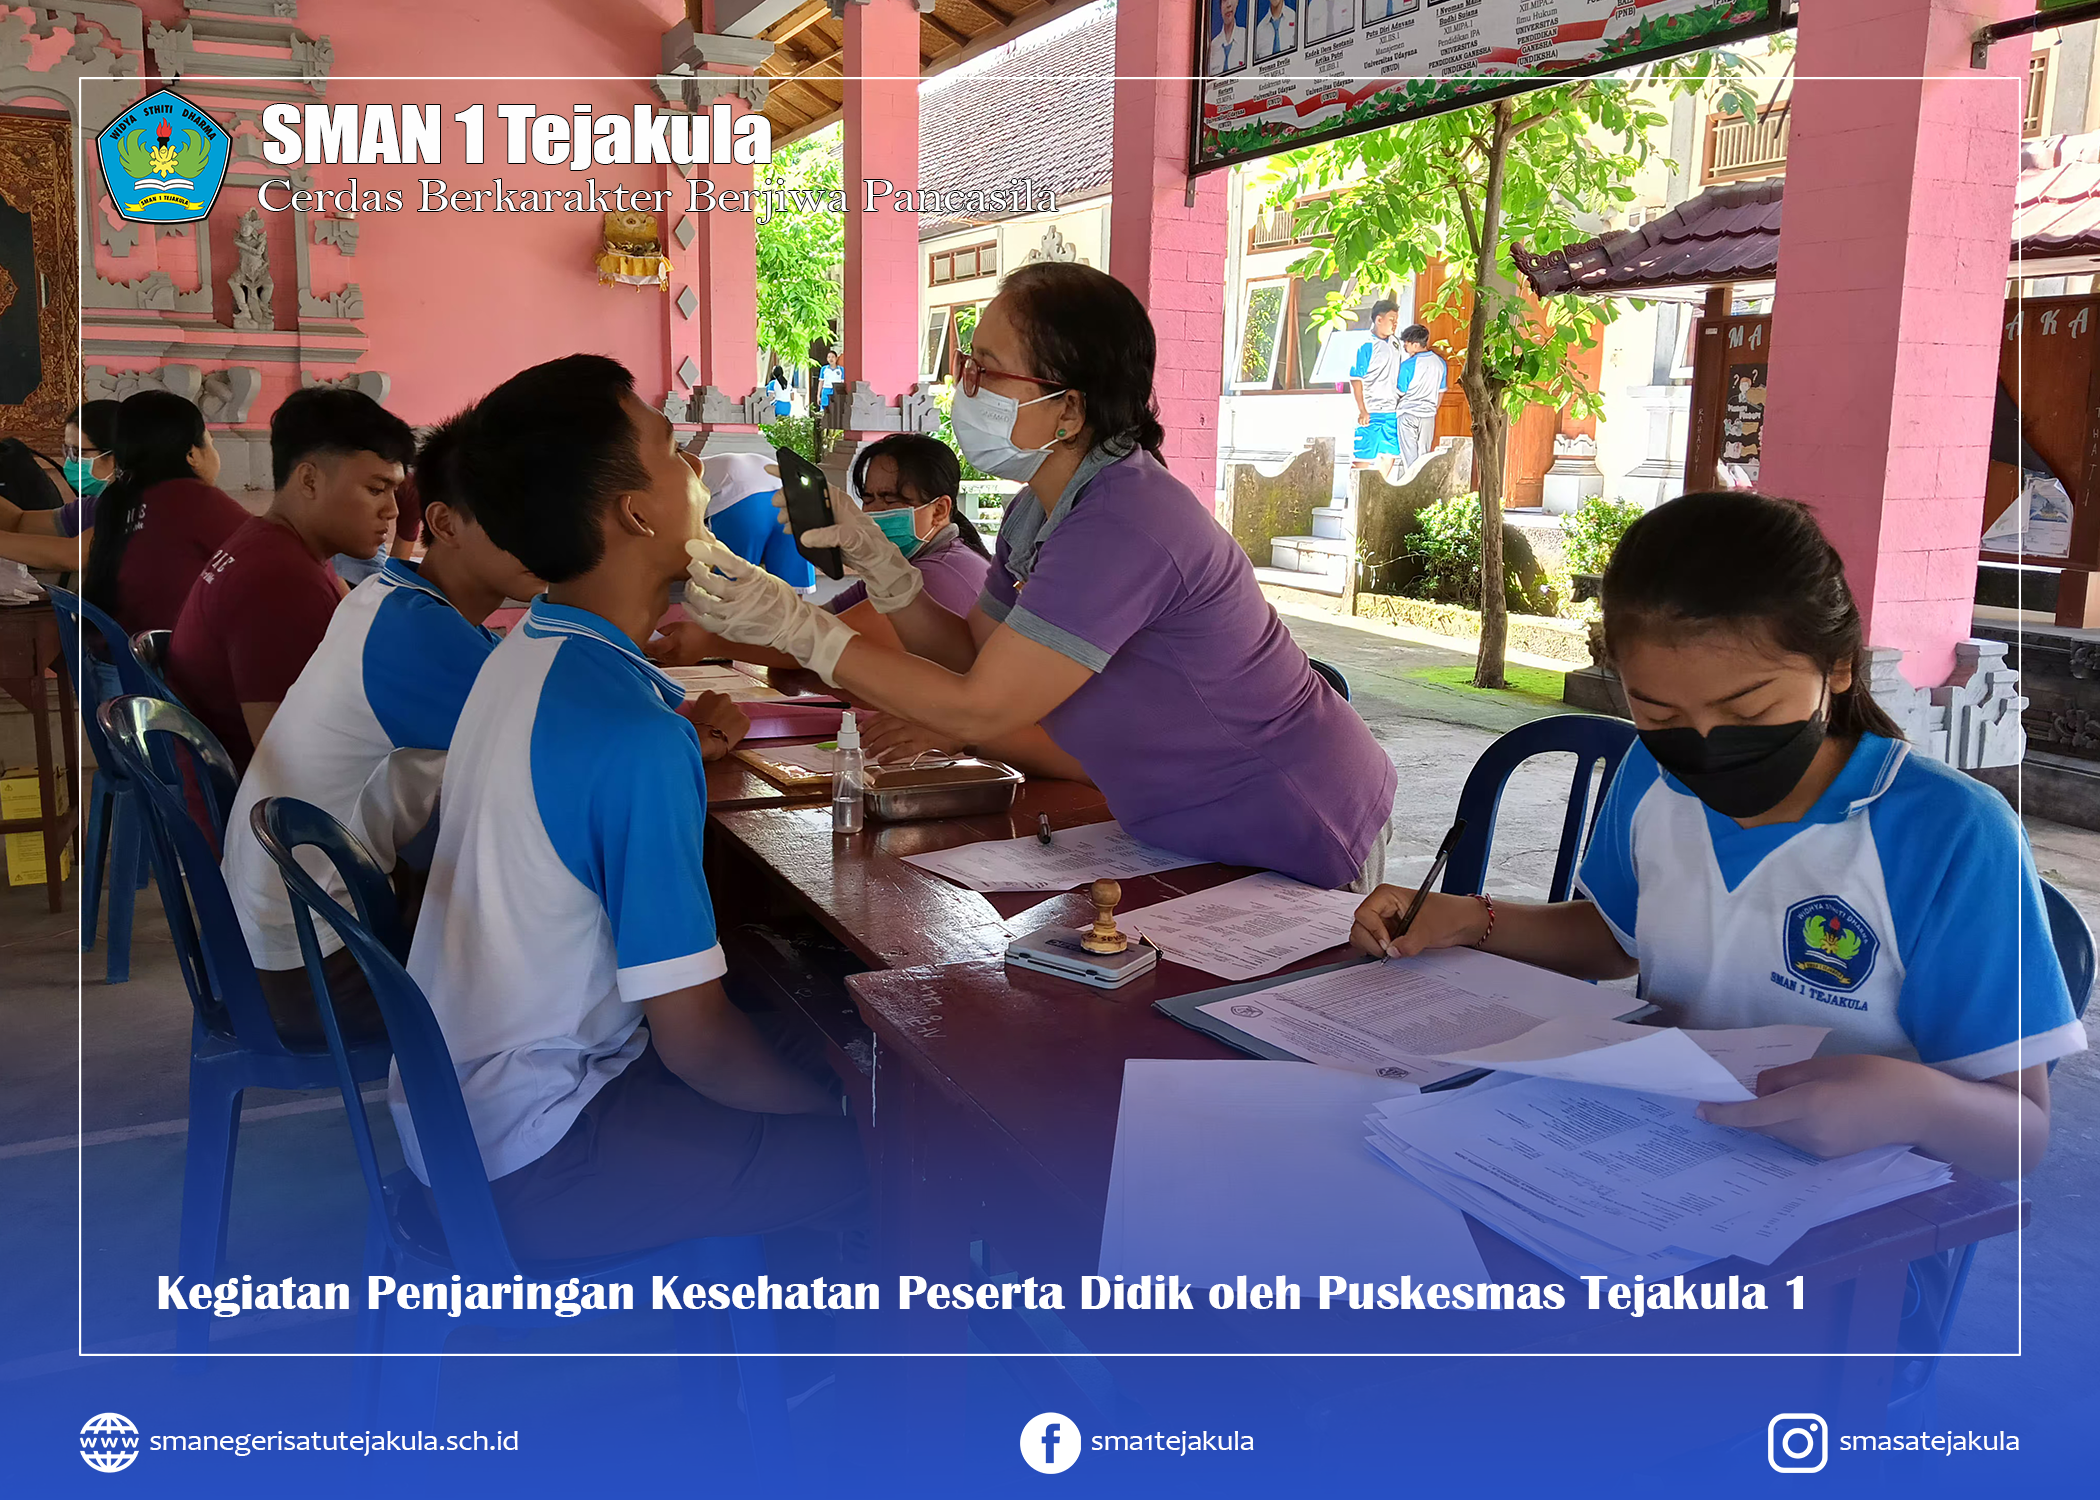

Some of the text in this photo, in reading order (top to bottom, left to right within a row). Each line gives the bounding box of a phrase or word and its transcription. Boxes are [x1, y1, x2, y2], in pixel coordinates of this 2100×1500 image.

[1517, 8, 1558, 24] Ilmu Hukum
[1616, 6, 1635, 20] (PNB)
[1470, 28, 1480, 38] IPA
[1516, 17, 1559, 34] UNIVERSITAS
[1518, 27, 1558, 44] PENDIDIKAN
[1440, 39, 1478, 56] UNIVERSITAS
[1522, 40, 1552, 53] GANESHA
[1429, 46, 1492, 69] PENDIDIKAN GANESHA
[1517, 48, 1559, 67] (UNDIKSHA)
[1846, 915, 1869, 944] DHARMA
[1770, 971, 1868, 1011] SMAN 1 TEJAKULA
